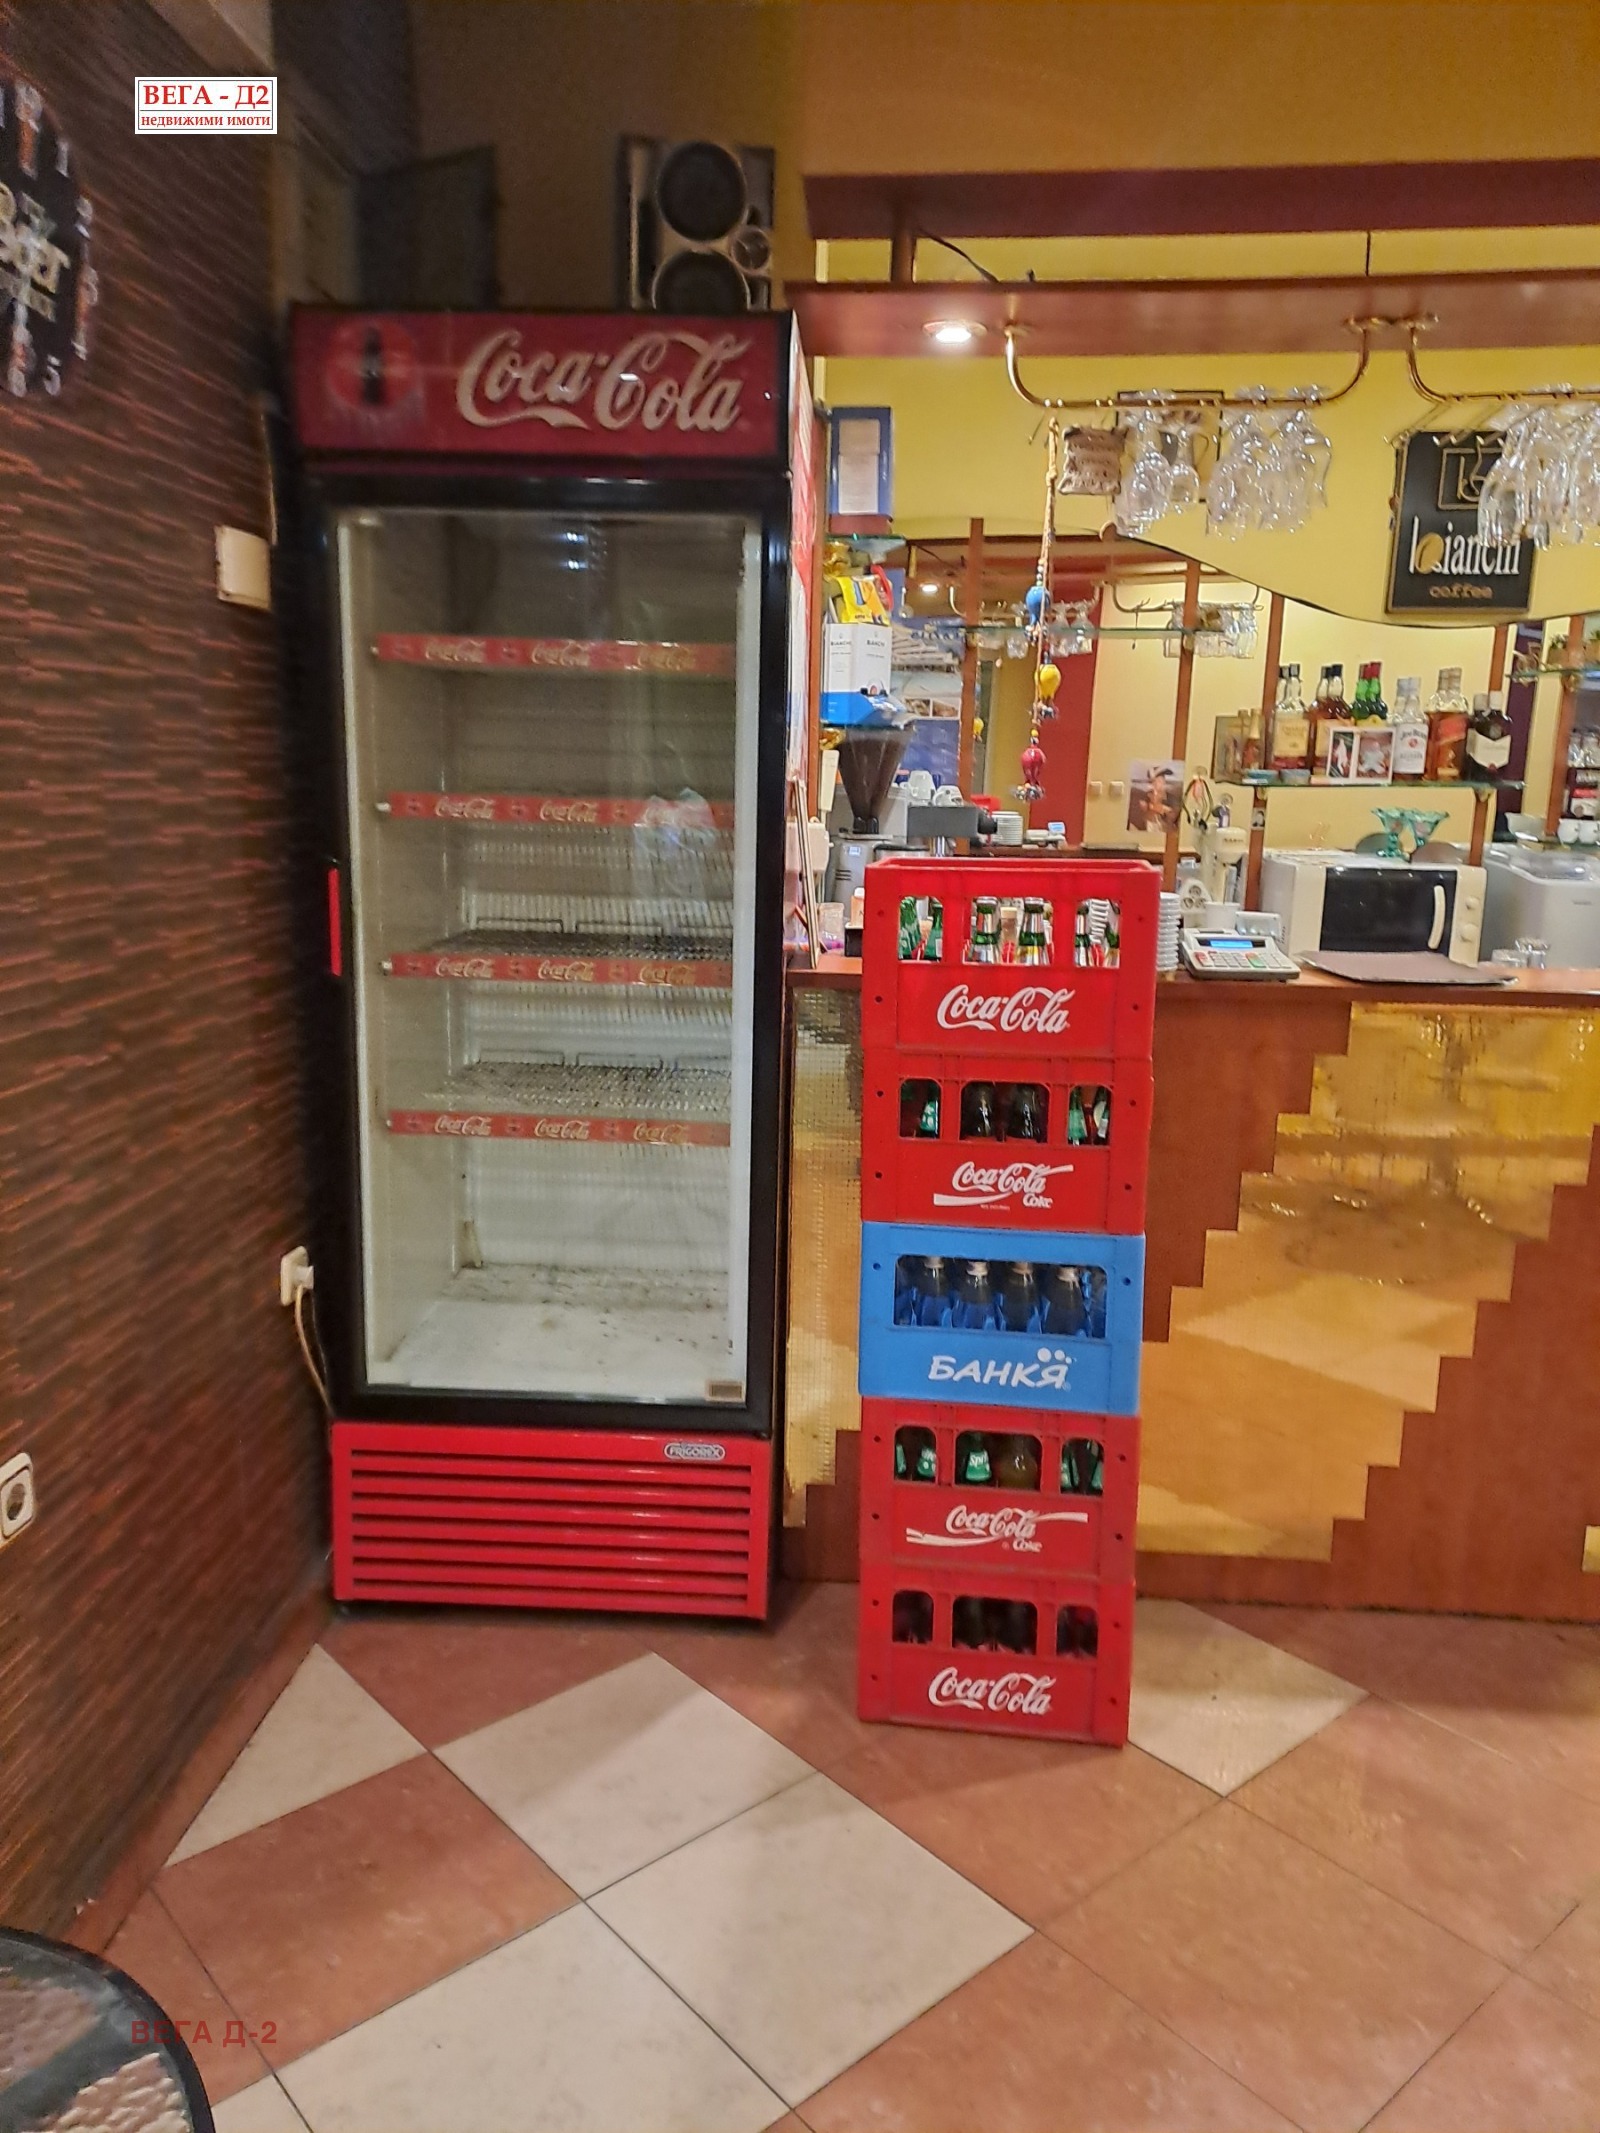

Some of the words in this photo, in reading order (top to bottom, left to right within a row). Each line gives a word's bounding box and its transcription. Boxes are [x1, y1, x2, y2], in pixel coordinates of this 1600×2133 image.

[455, 328, 753, 433] Coca-Cola
[1430, 582, 1493, 599] coffee
[937, 984, 1075, 1034] Coca-Cola
[952, 1161, 1073, 1193] Coca-Cola
[1023, 1193, 1053, 1209] Coke
[928, 1354, 1069, 1390] БАНКЯ
[946, 1505, 1074, 1539] Coca-Cola
[1013, 1539, 1043, 1553] Coke
[928, 1666, 1057, 1716] Coca-Cola
